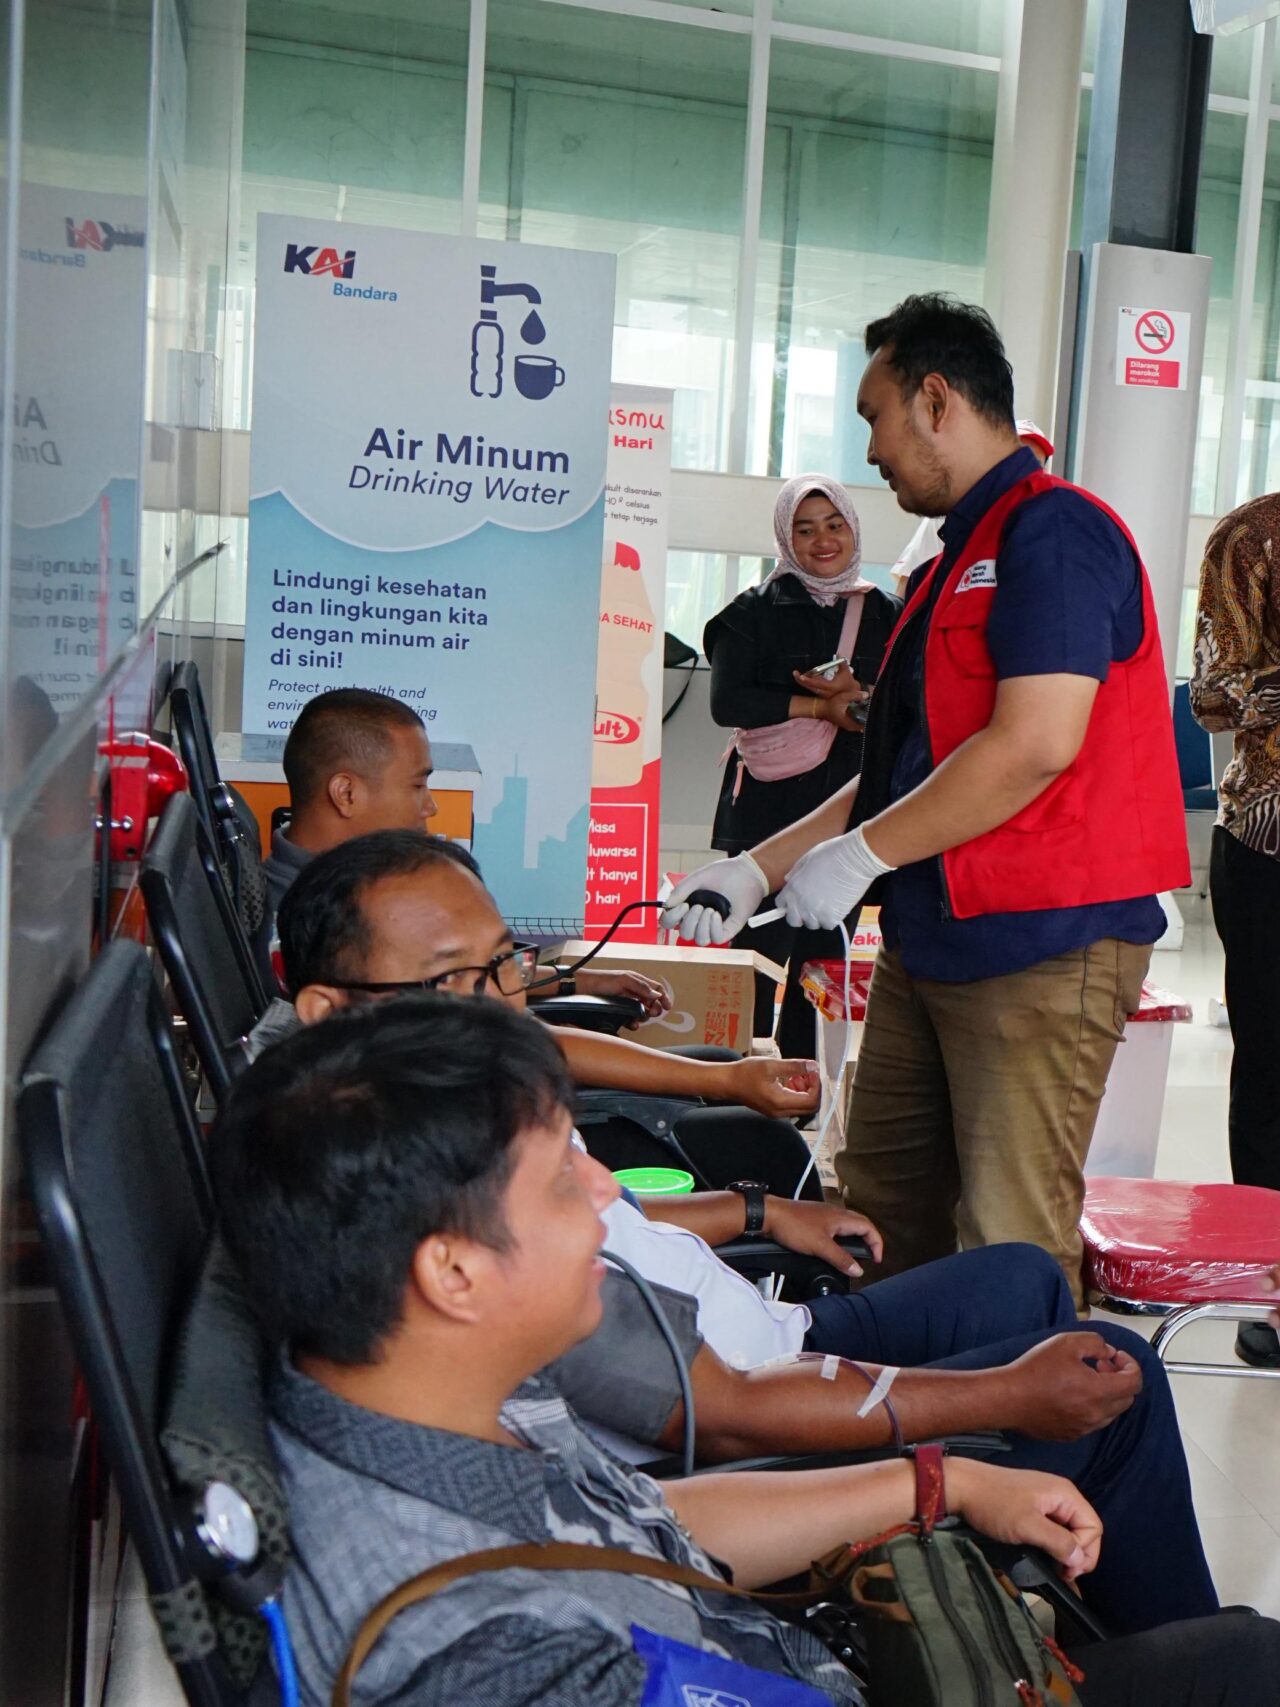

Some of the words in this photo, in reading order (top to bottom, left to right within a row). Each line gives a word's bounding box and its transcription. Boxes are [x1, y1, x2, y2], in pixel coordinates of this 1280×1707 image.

[284, 244, 356, 279] KAI
[333, 282, 398, 302] Bandara
[363, 427, 424, 461] Air
[436, 433, 570, 474] Minum
[613, 434, 653, 450] Hari
[348, 465, 473, 503] Drinking
[485, 475, 570, 505] Water
[624, 485, 662, 497] disarankan
[625, 500, 650, 510] celsius
[610, 512, 631, 522] tetap
[633, 513, 659, 525] terjaga
[273, 569, 370, 595] Lindungi
[377, 575, 487, 600] kesehatan
[272, 596, 313, 615] dan
[320, 598, 442, 625] lingkungan
[449, 607, 488, 626] kita
[613, 614, 653, 633] SEHAT
[271, 622, 354, 646] dengan
[361, 628, 435, 648] minum
[442, 633, 470, 650] air
[270, 648, 291, 666] di
[298, 650, 343, 668] sini!
[268, 679, 320, 693] Protect
[399, 687, 426, 699] and
[268, 699, 304, 711] envir
[267, 719, 295, 730] wat
[600, 866, 638, 885] hanya
[595, 890, 621, 904] hari
